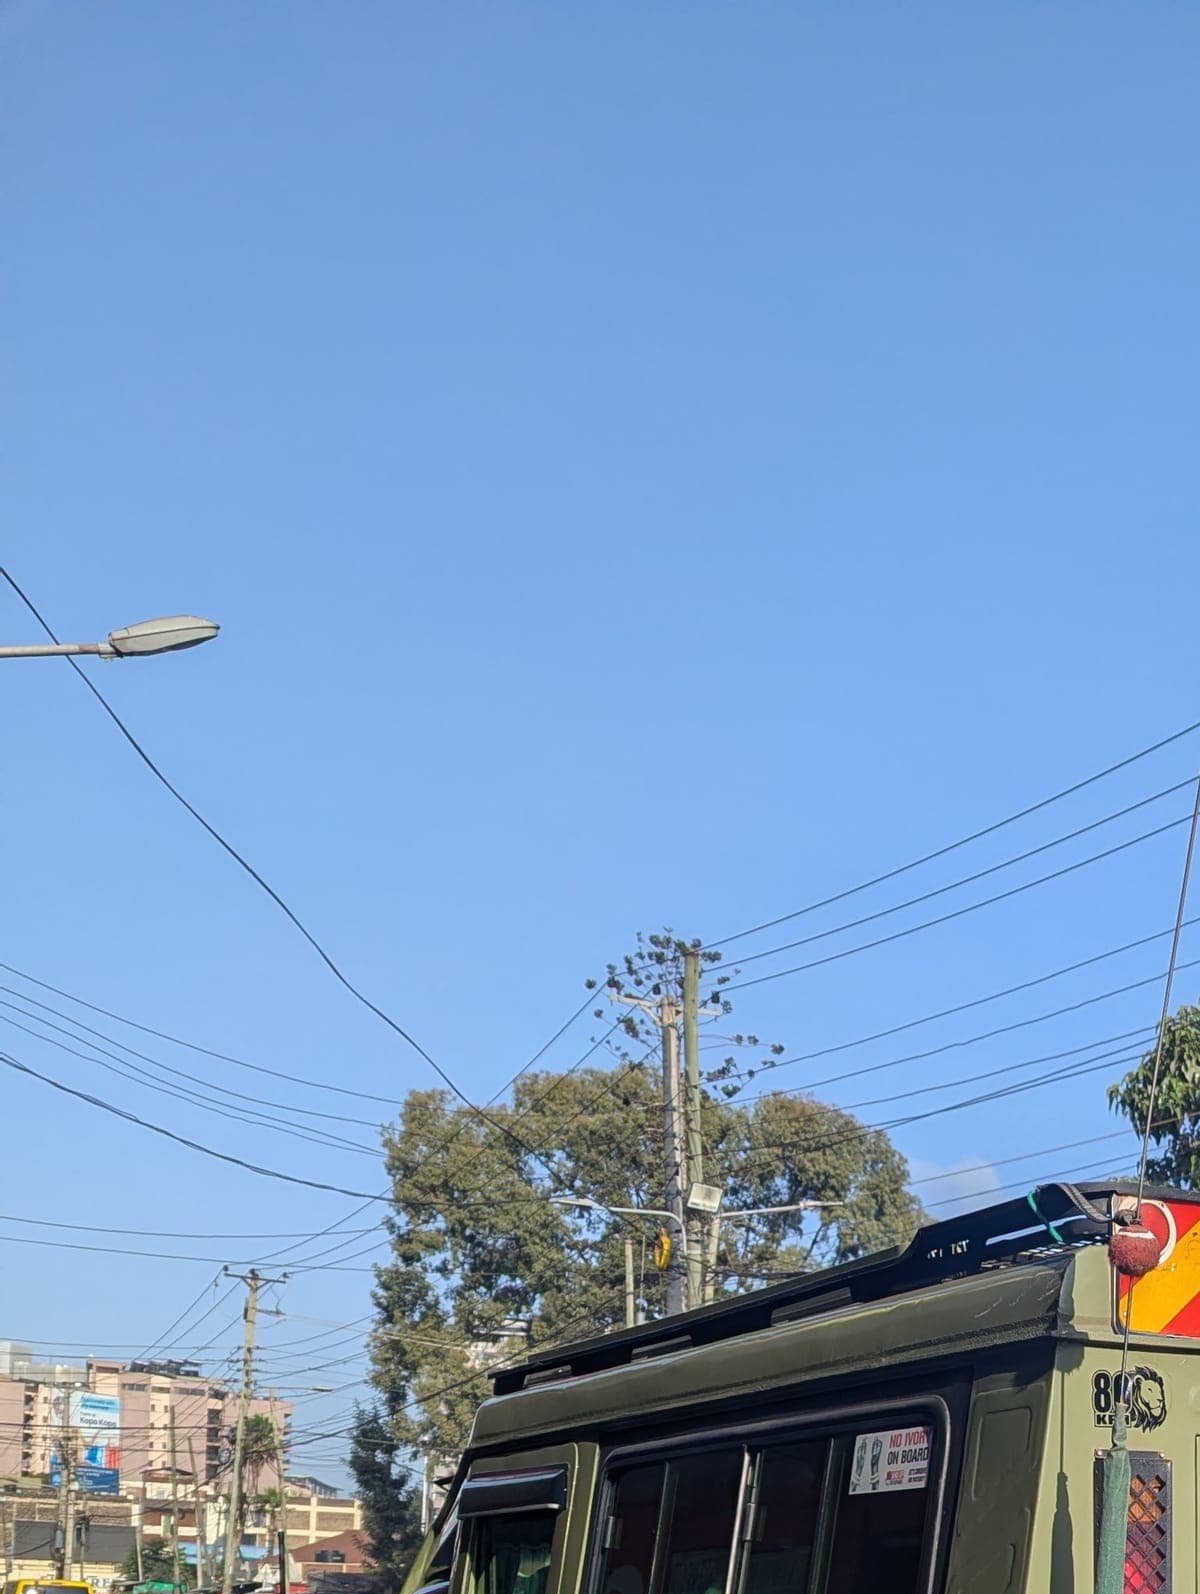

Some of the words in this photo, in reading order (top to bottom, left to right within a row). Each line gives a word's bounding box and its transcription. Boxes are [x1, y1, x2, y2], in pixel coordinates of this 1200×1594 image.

[890, 1433, 902, 1448] NO
[887, 1451, 899, 1465] ON
[901, 1447, 929, 1464] BOARD
